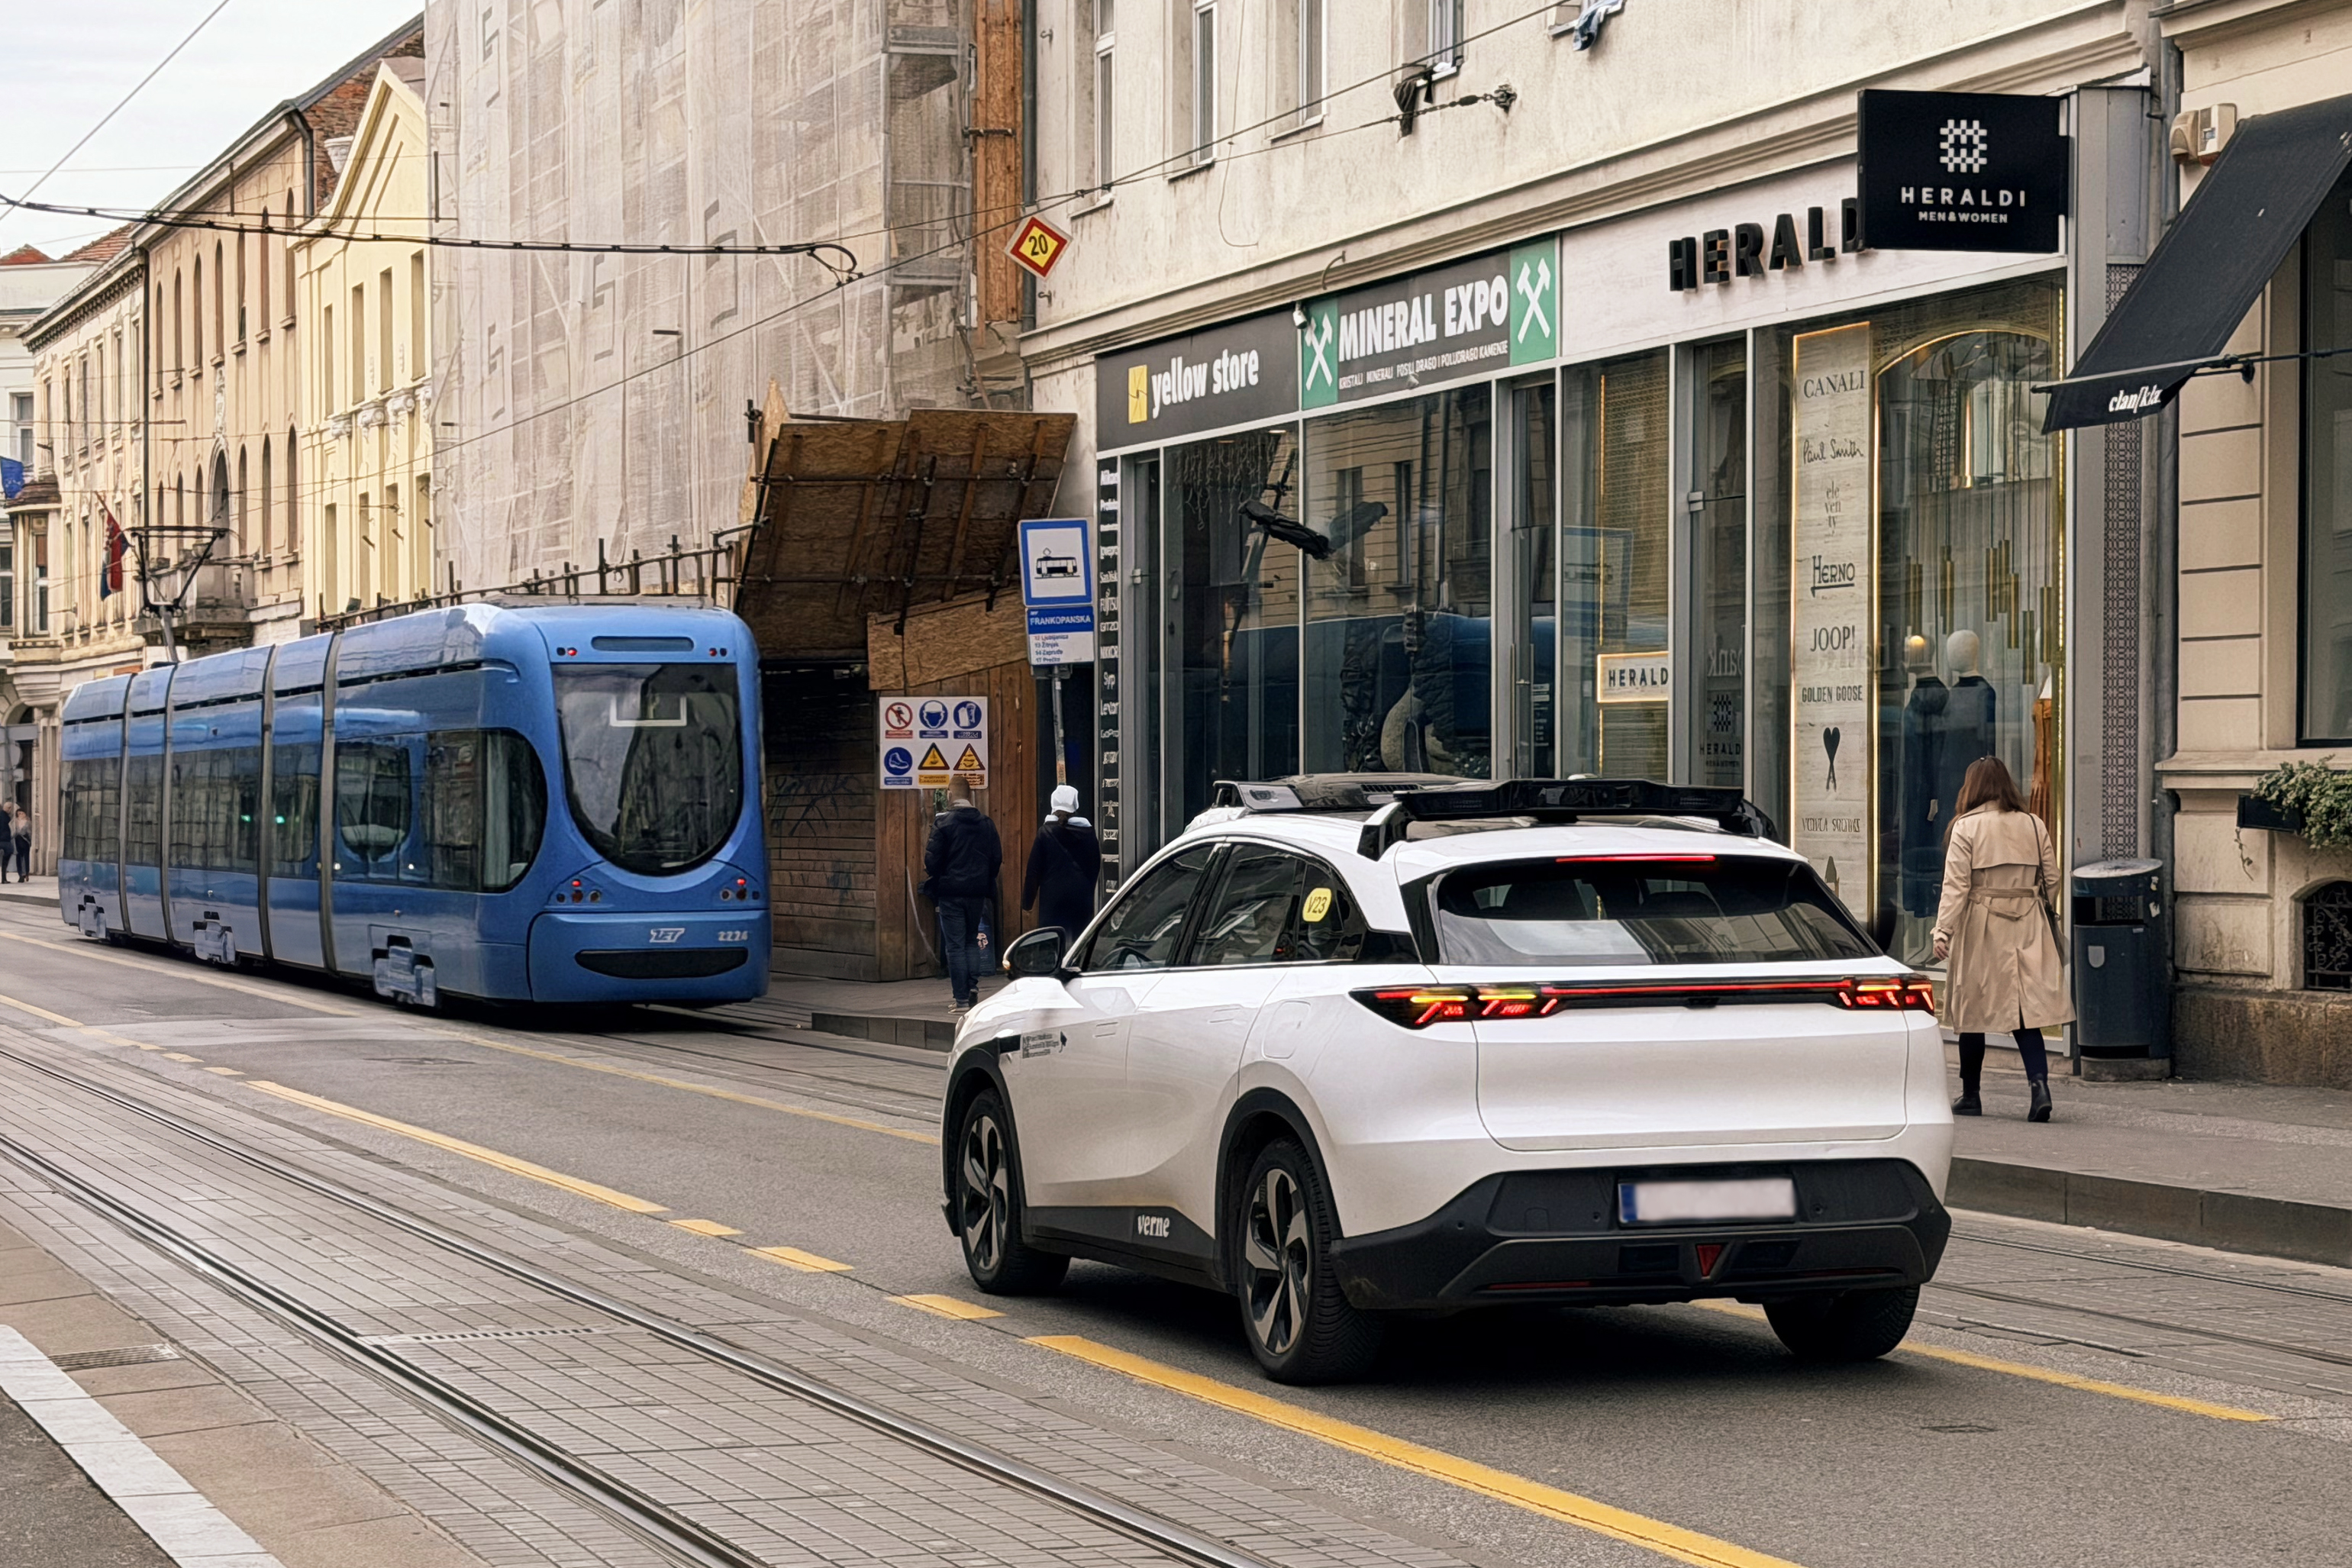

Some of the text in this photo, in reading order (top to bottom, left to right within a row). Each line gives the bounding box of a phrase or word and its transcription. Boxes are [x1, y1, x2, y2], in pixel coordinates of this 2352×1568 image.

[1901, 186, 2025, 207] HERALDI
[1918, 211, 2008, 224] MEN&WOMEN
[1028, 234, 1049, 256] 20
[1338, 275, 1508, 363] MINERAL EXPO
[1150, 348, 1259, 419] yellow store
[1803, 369, 1865, 398] CANALI
[1803, 437, 1864, 465] Paul Smith
[1030, 615, 1091, 626] FRANKOPANSKA
[1810, 624, 1855, 652] JOOP!
[1802, 685, 1863, 703] GOLDEN GOOSE
[1307, 895, 1328, 914] V23
[1137, 1214, 1170, 1238] verne
